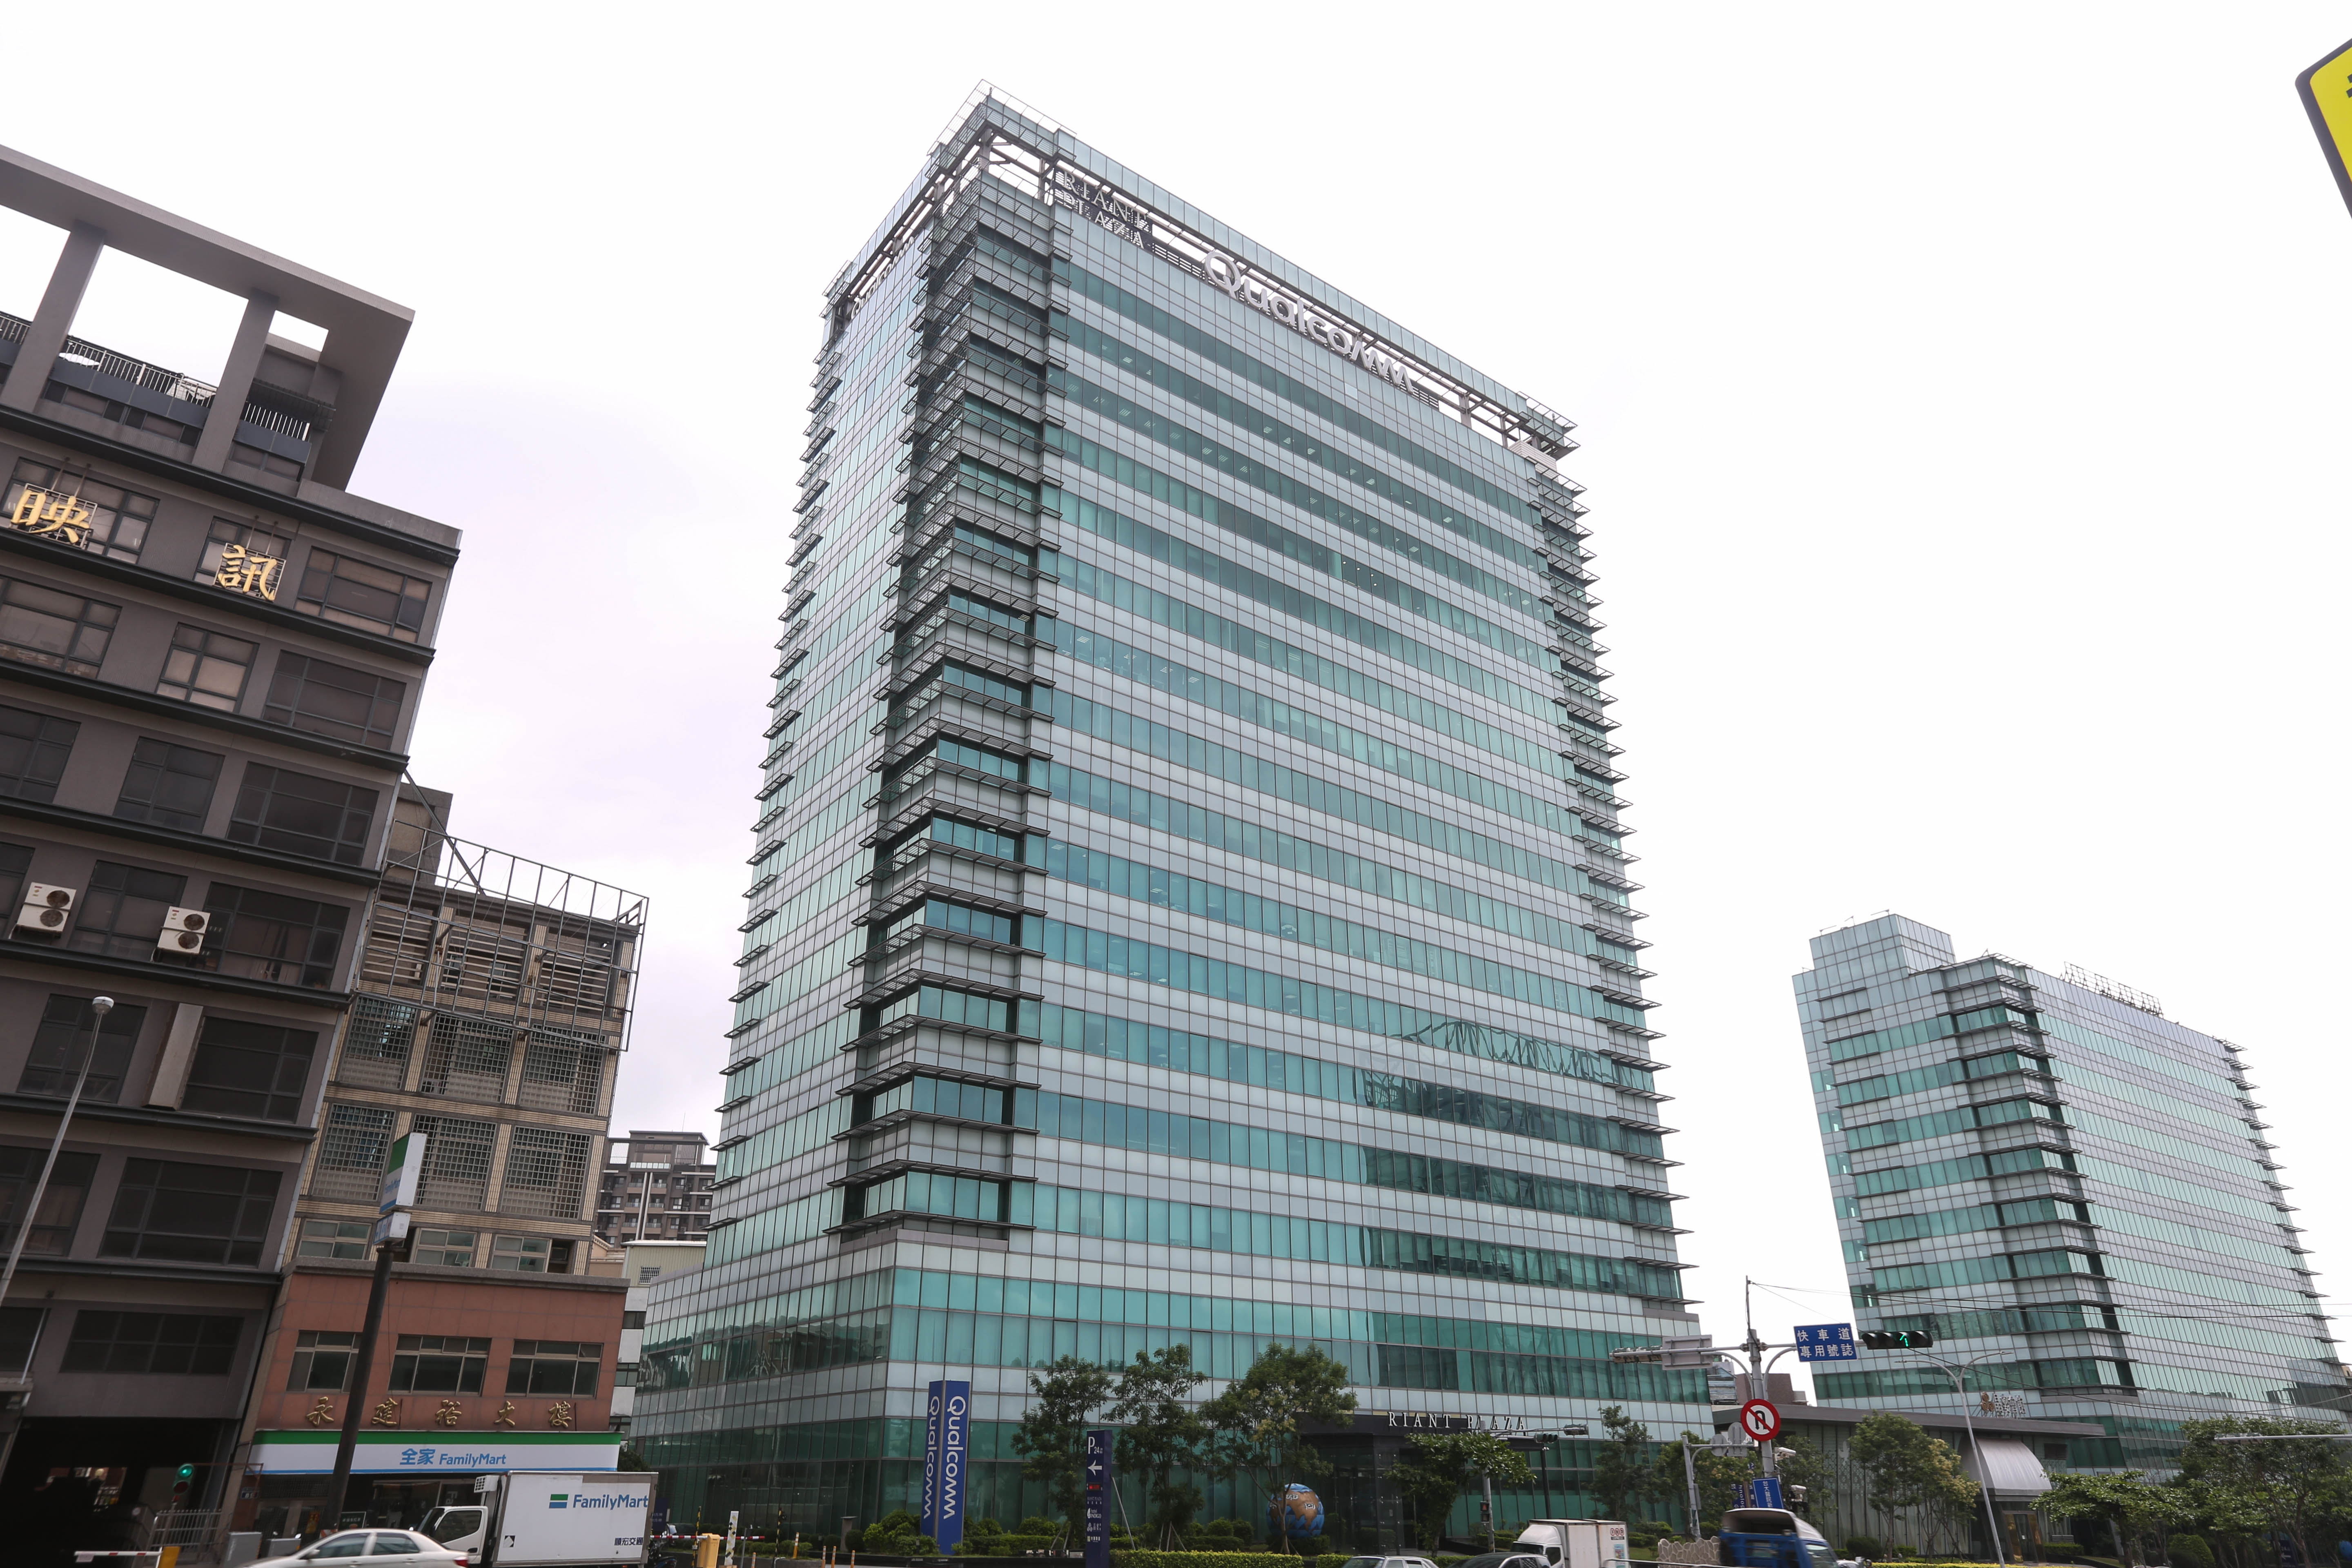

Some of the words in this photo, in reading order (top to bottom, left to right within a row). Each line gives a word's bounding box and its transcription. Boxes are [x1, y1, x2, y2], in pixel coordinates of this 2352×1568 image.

[1064, 170, 1147, 231] RIANT
[1204, 251, 1414, 394] Qualcomm
[1797, 1327, 1851, 1342] 快車道
[1800, 1343, 1853, 1358] 專用號誌
[1388, 1412, 1450, 1428] RIANT
[400, 1448, 436, 1465] 全家
[439, 1453, 506, 1467] FamilyMart
[924, 1396, 940, 1519] Qualcomm
[943, 1396, 966, 1519] Qualcomm
[573, 1494, 648, 1510] FamilyMart
